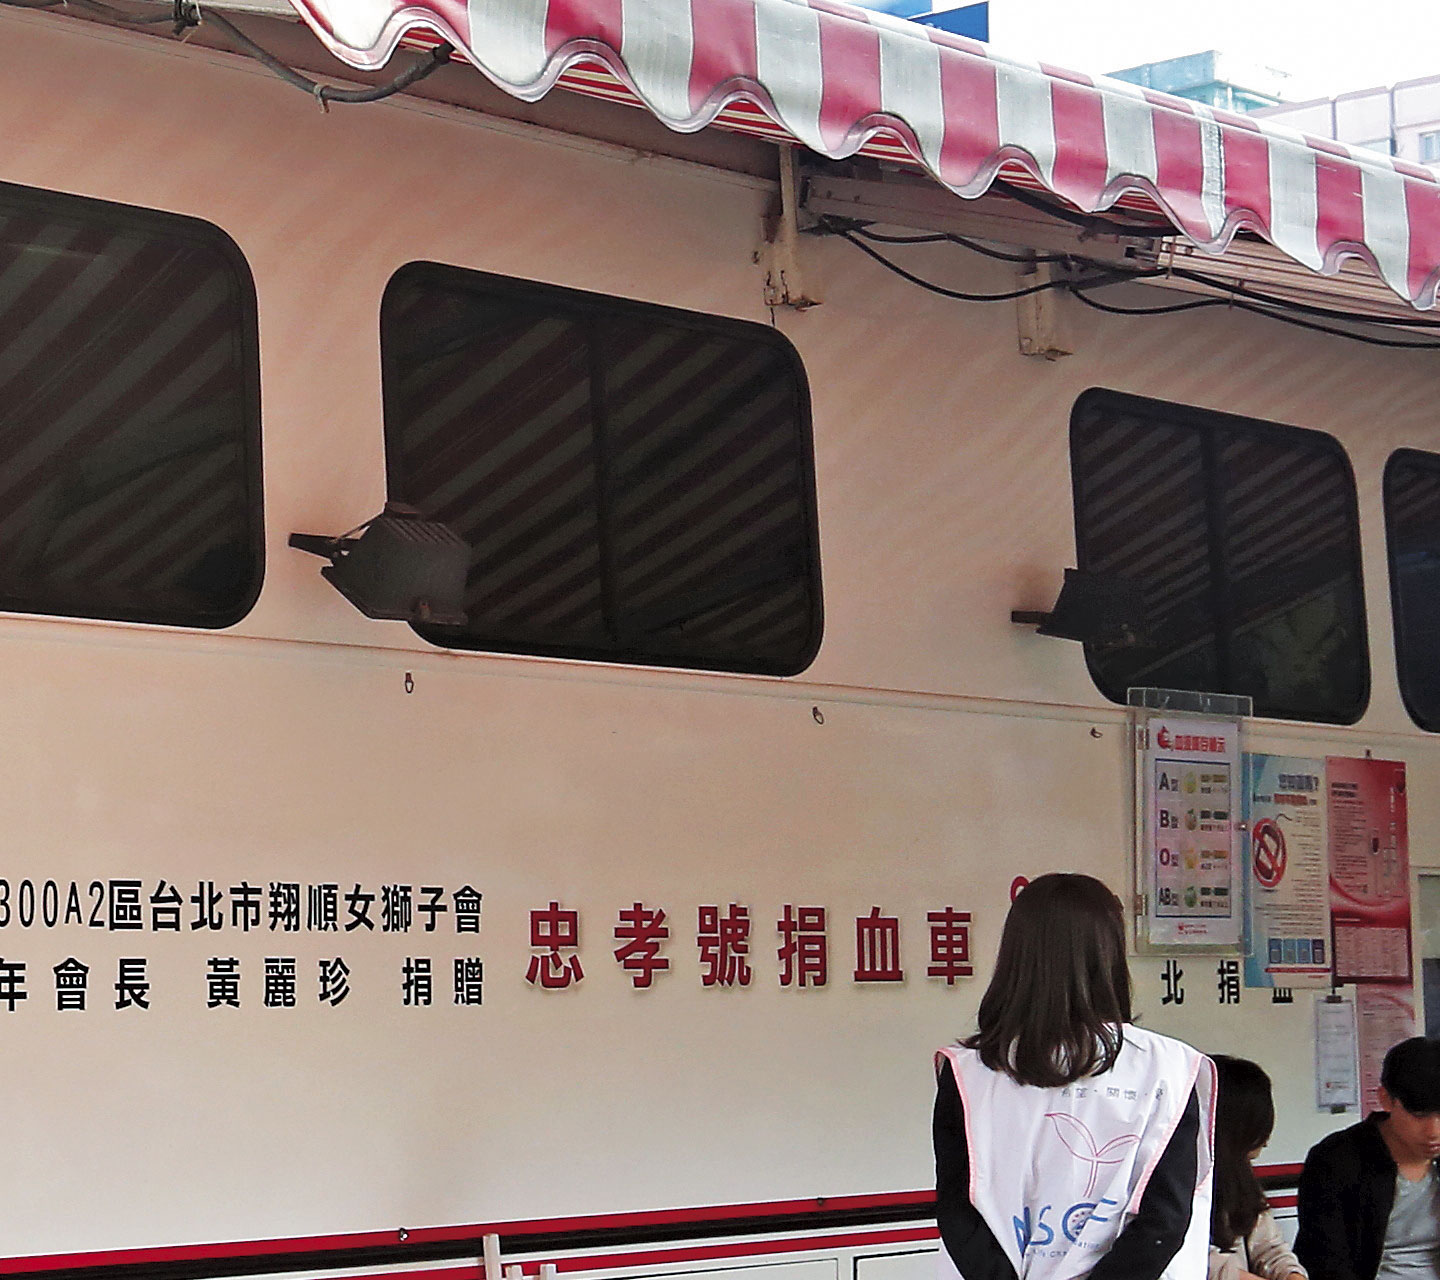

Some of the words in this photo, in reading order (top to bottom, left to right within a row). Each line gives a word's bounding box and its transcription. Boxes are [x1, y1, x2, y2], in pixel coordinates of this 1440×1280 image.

[525, 901, 975, 990] 忠孝號捐血車
[52, 957, 151, 1011] 會長
[207, 957, 352, 1010] 黃麗珍
[402, 957, 484, 1007] 捐贈
